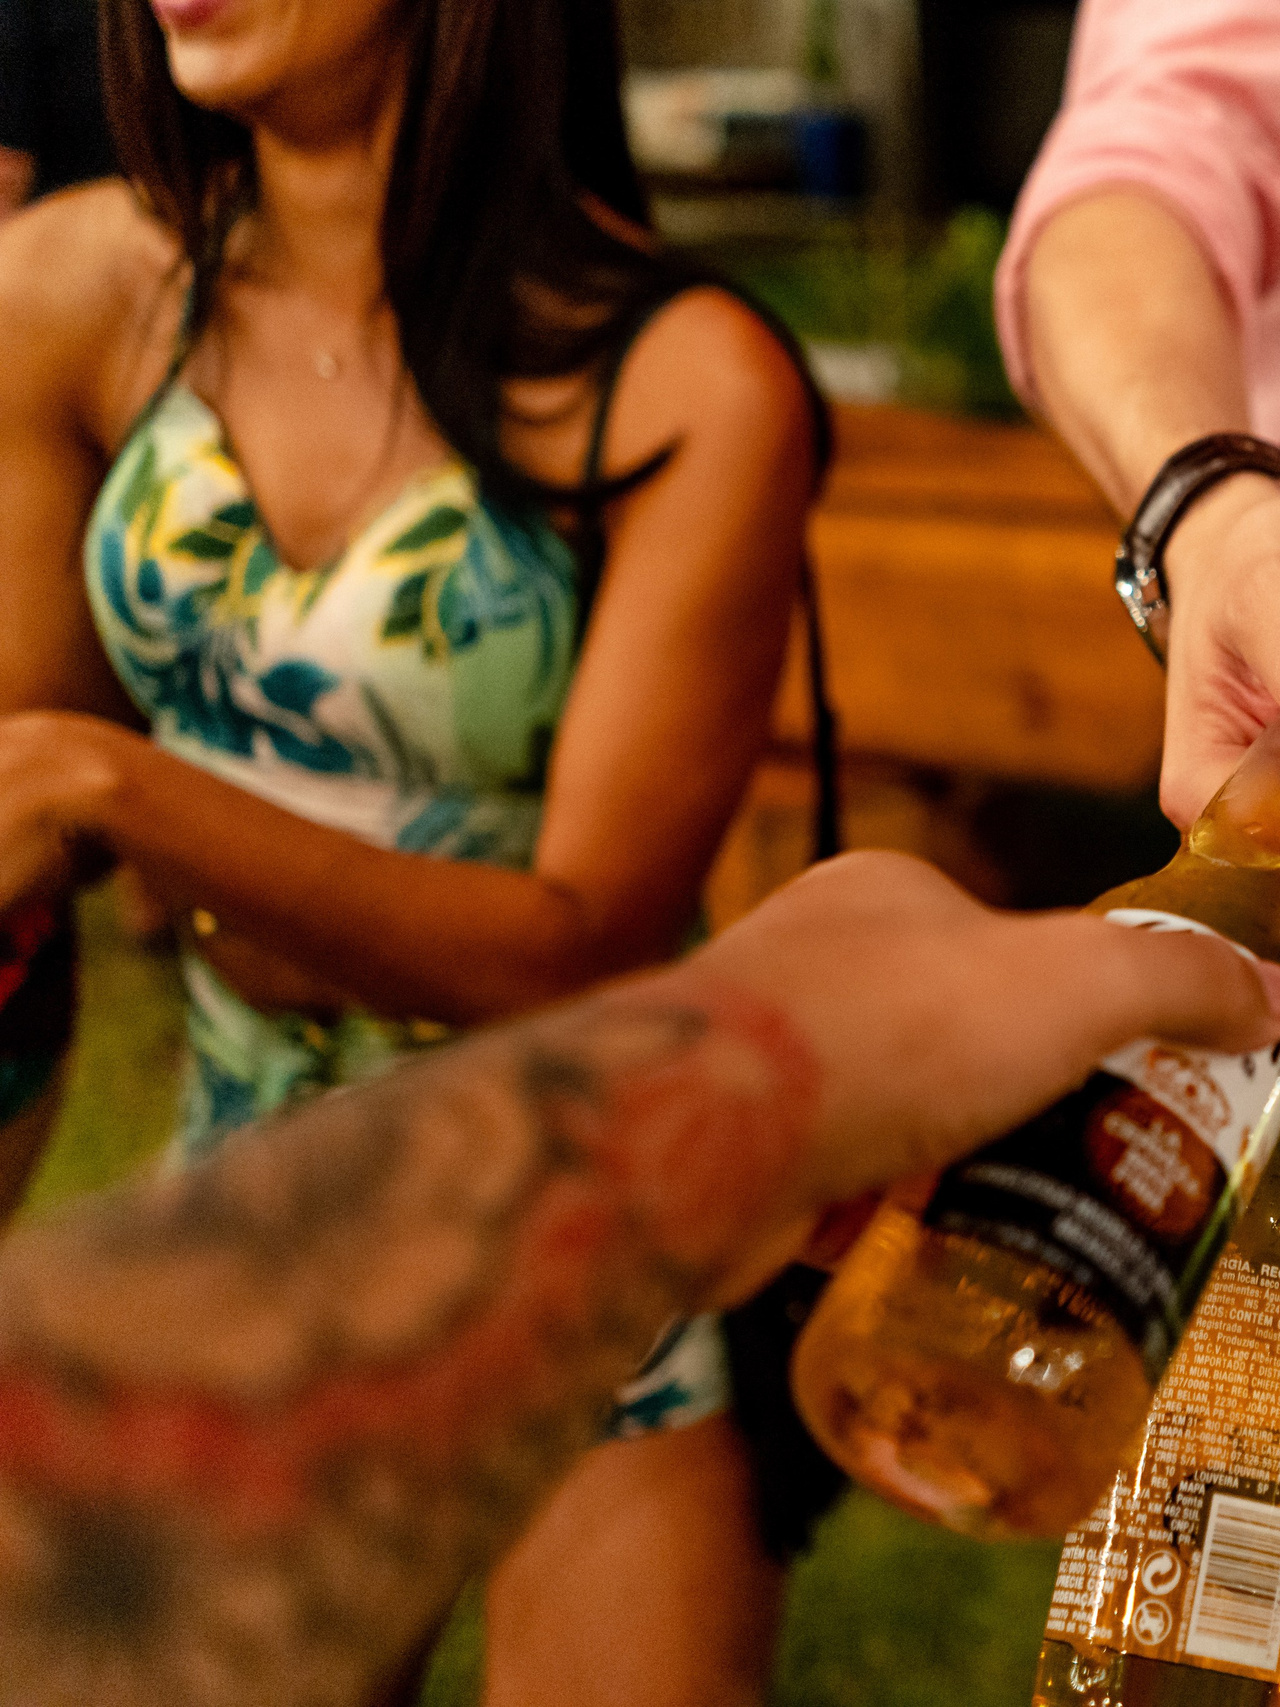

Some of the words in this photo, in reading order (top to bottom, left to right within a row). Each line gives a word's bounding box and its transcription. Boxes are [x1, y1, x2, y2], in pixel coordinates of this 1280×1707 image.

[1218, 1257, 1255, 1274] RGIA.
[1238, 1271, 1258, 1285] local
[1260, 1278, 1279, 1289] seco
[1211, 1281, 1262, 1299] ngredientes:
[1200, 1303, 1227, 1317] ICOS:
[1229, 1308, 1273, 1327] CONTÉM
[1196, 1317, 1243, 1335] Registrada
[1217, 1332, 1260, 1350] Produzido
[1194, 1353, 1246, 1371] IMPORTADO
[1212, 1370, 1249, 1386] BIAGINO
[1215, 1396, 1237, 1409] 2230
[1252, 1390, 1276, 1404] MAPA
[1159, 1425, 1183, 1438] MAPA
[1205, 1418, 1220, 1431] RIO
[1237, 1425, 1273, 1444] JANEIRO
[1152, 1438, 1179, 1451] LAGES
[1179, 1480, 1206, 1496] MAPA
[1194, 1470, 1239, 1489] LOUVEIRA
